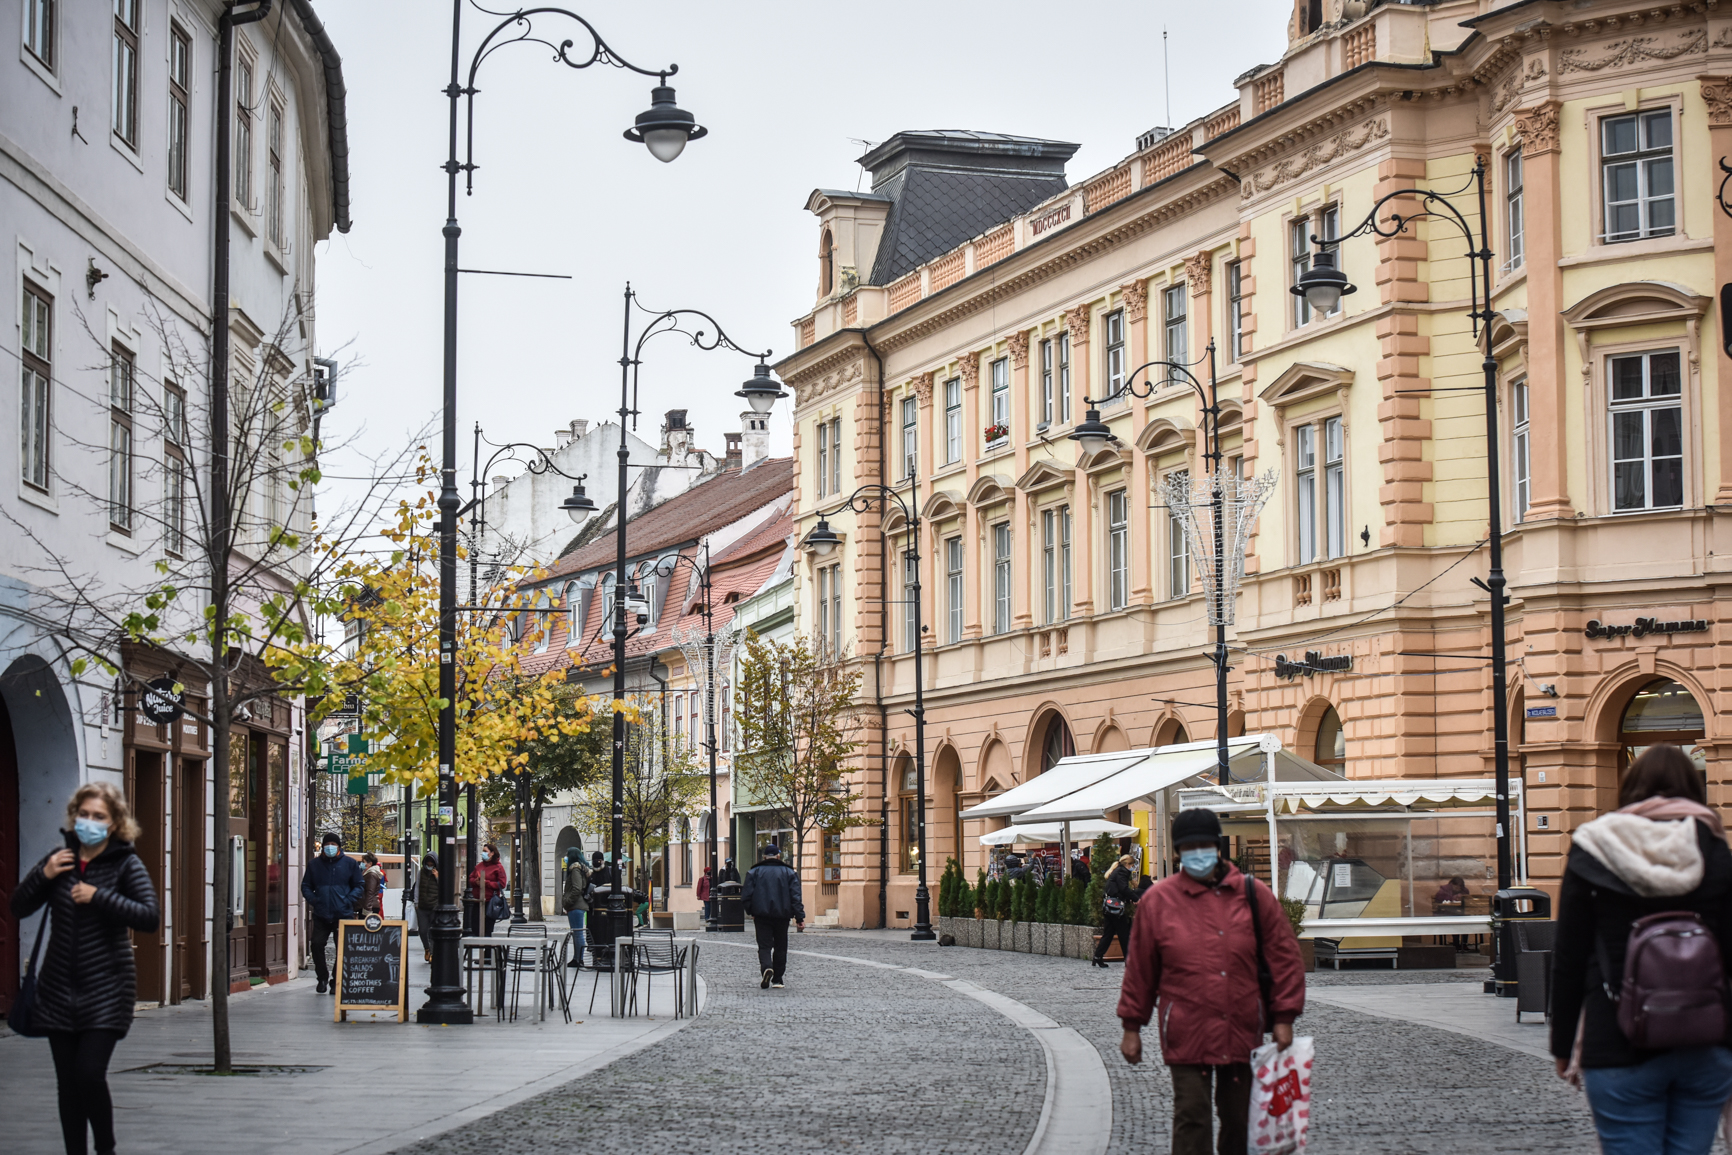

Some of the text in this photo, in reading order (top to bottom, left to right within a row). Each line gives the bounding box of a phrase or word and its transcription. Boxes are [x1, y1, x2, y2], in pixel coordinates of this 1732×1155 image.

[1585, 616, 1708, 641] Super Mamma
[1275, 649, 1352, 682] Super Mamma
[153, 703, 173, 714] Juice
[348, 934, 383, 944] HEALTHY
[349, 979, 382, 987] SMOOTHIES
